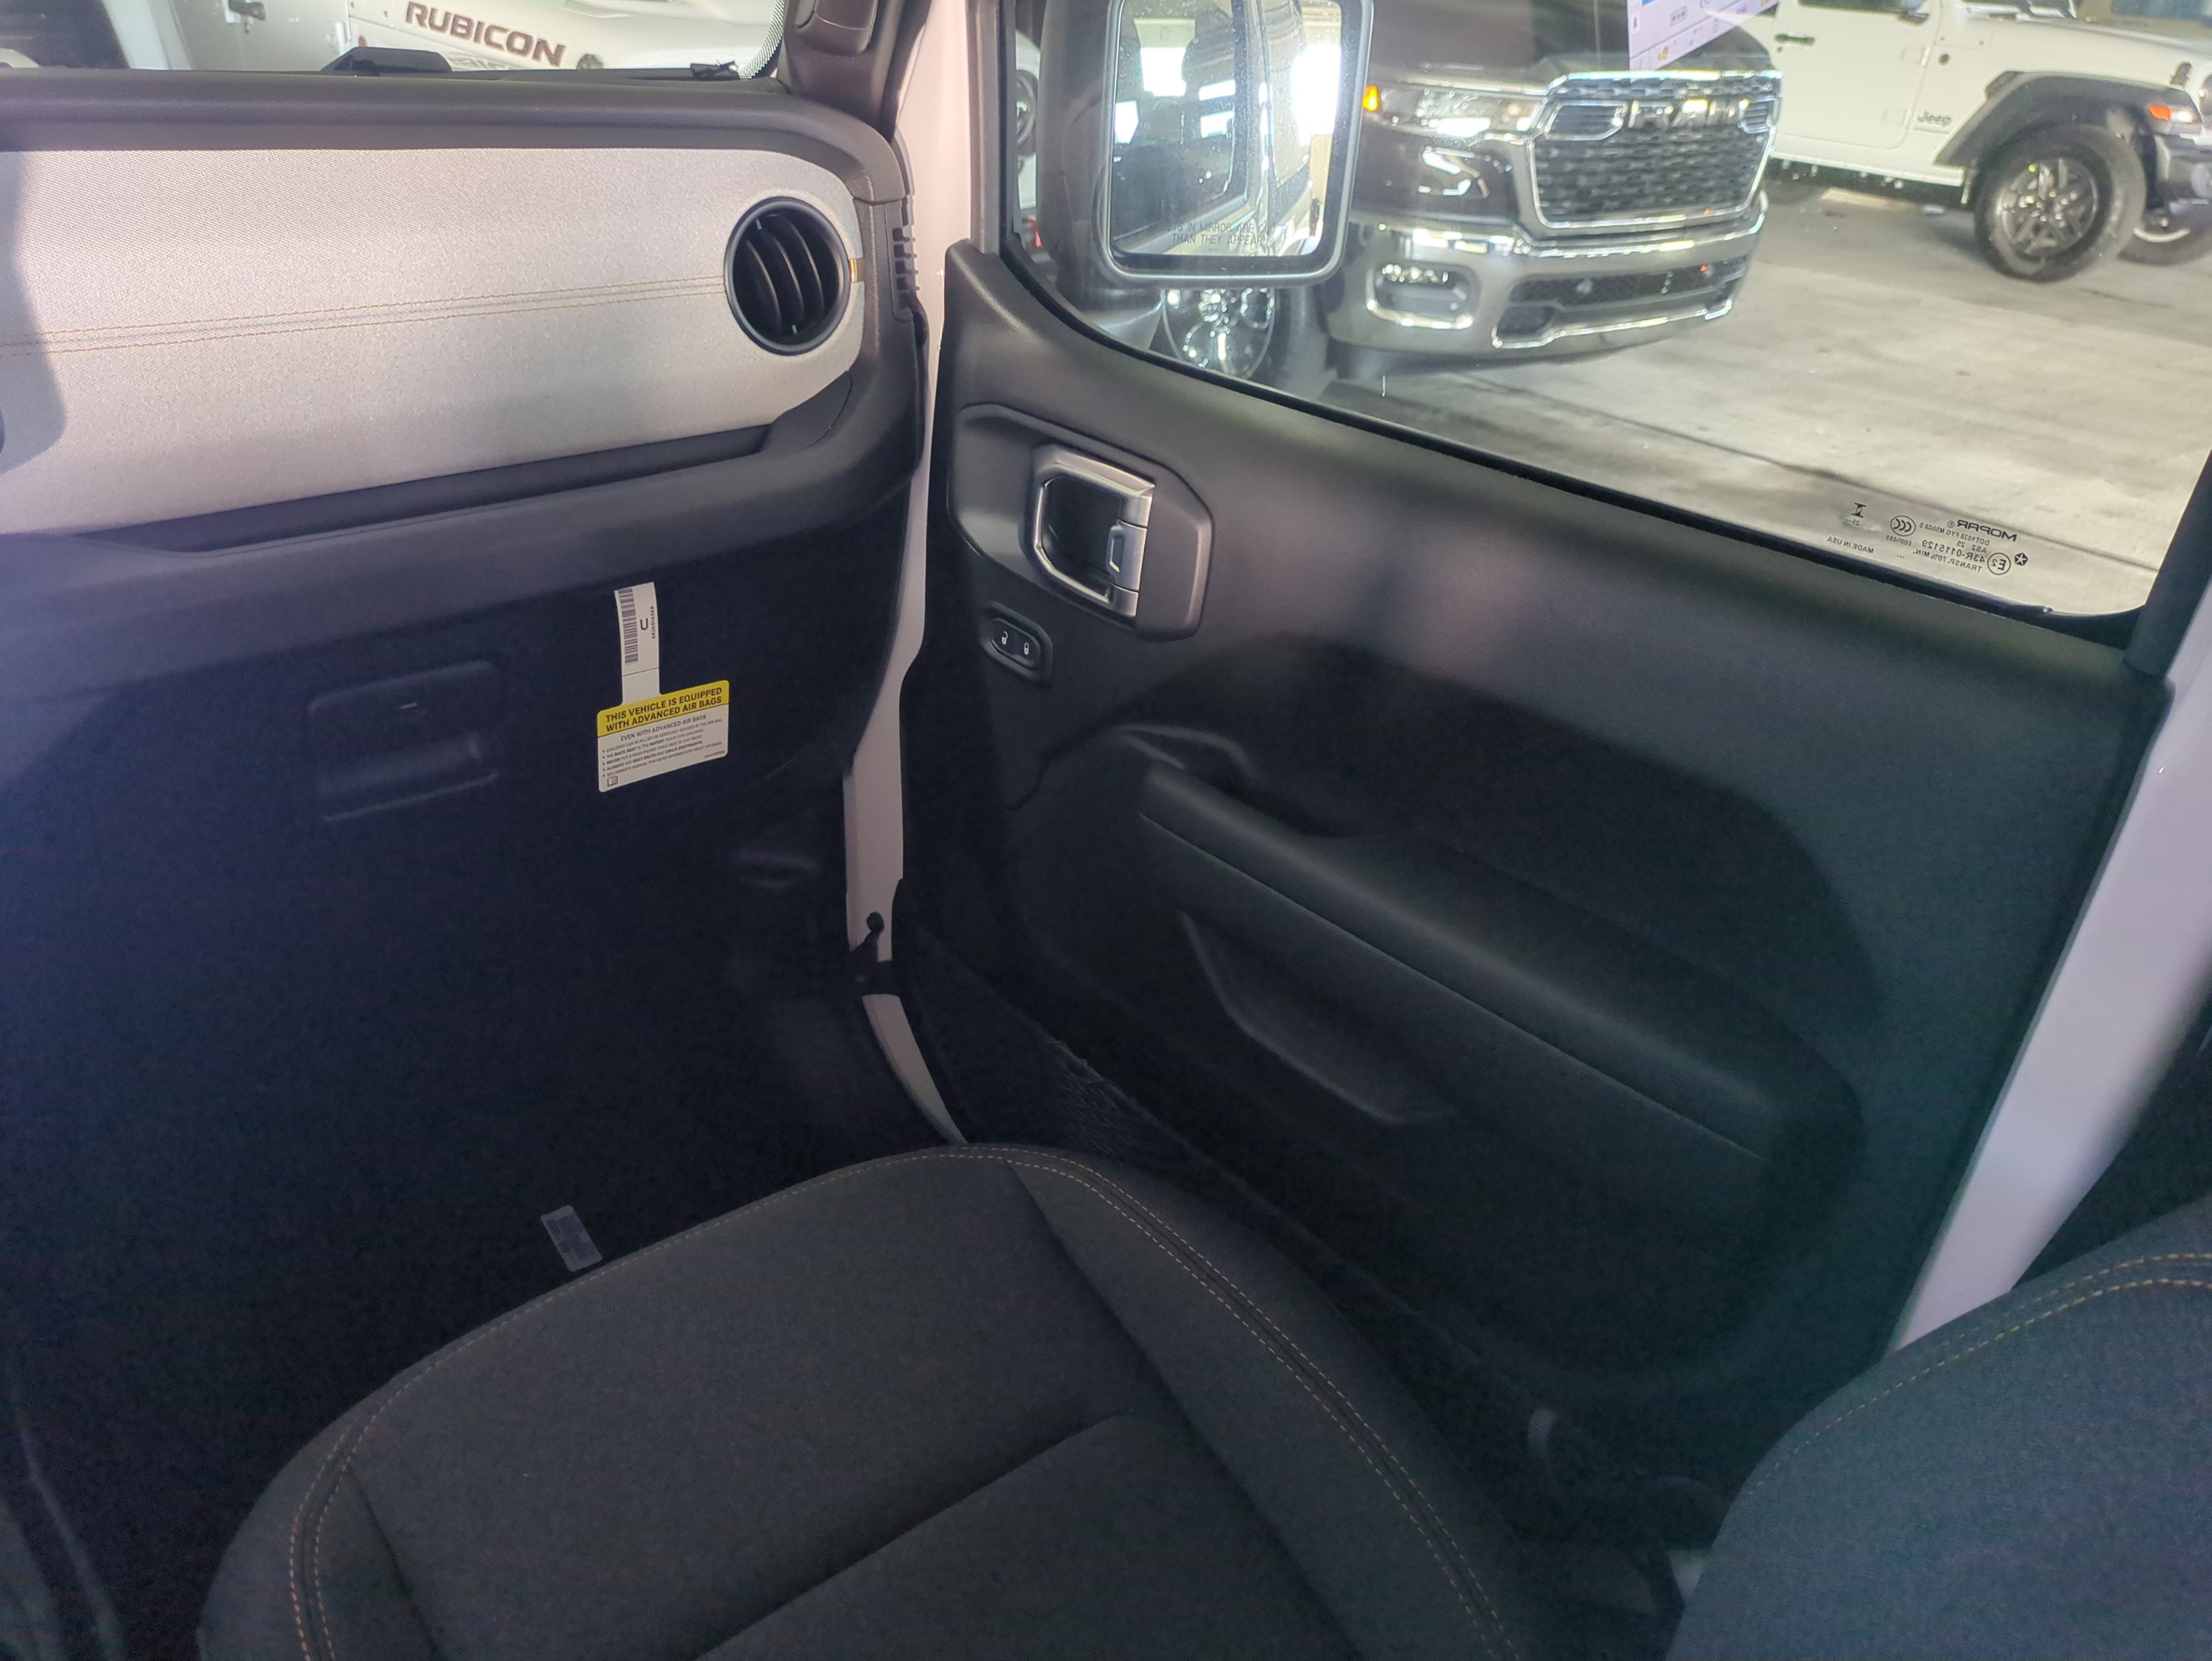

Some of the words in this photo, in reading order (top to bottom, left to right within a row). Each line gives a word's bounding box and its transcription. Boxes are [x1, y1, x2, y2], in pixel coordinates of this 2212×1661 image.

[406, 1, 567, 67] RUBICON
[1917, 111, 1952, 128] Jeep
[1172, 233, 1195, 244] THAN
[1201, 234, 1222, 244] THEY
[1228, 234, 1263, 245] APPEAR
[640, 618, 649, 631] U
[606, 711, 626, 722] THIS
[629, 700, 666, 715] VEHICLE
[668, 698, 677, 707] IS
[679, 687, 722, 704] EQUIPPED
[606, 720, 629, 732] WITH
[632, 707, 680, 725] ADVANCED
[683, 703, 697, 712] AIR
[699, 696, 721, 708] BAGS
[621, 733, 635, 742] EVEN
[652, 721, 681, 732] ADVANCED
